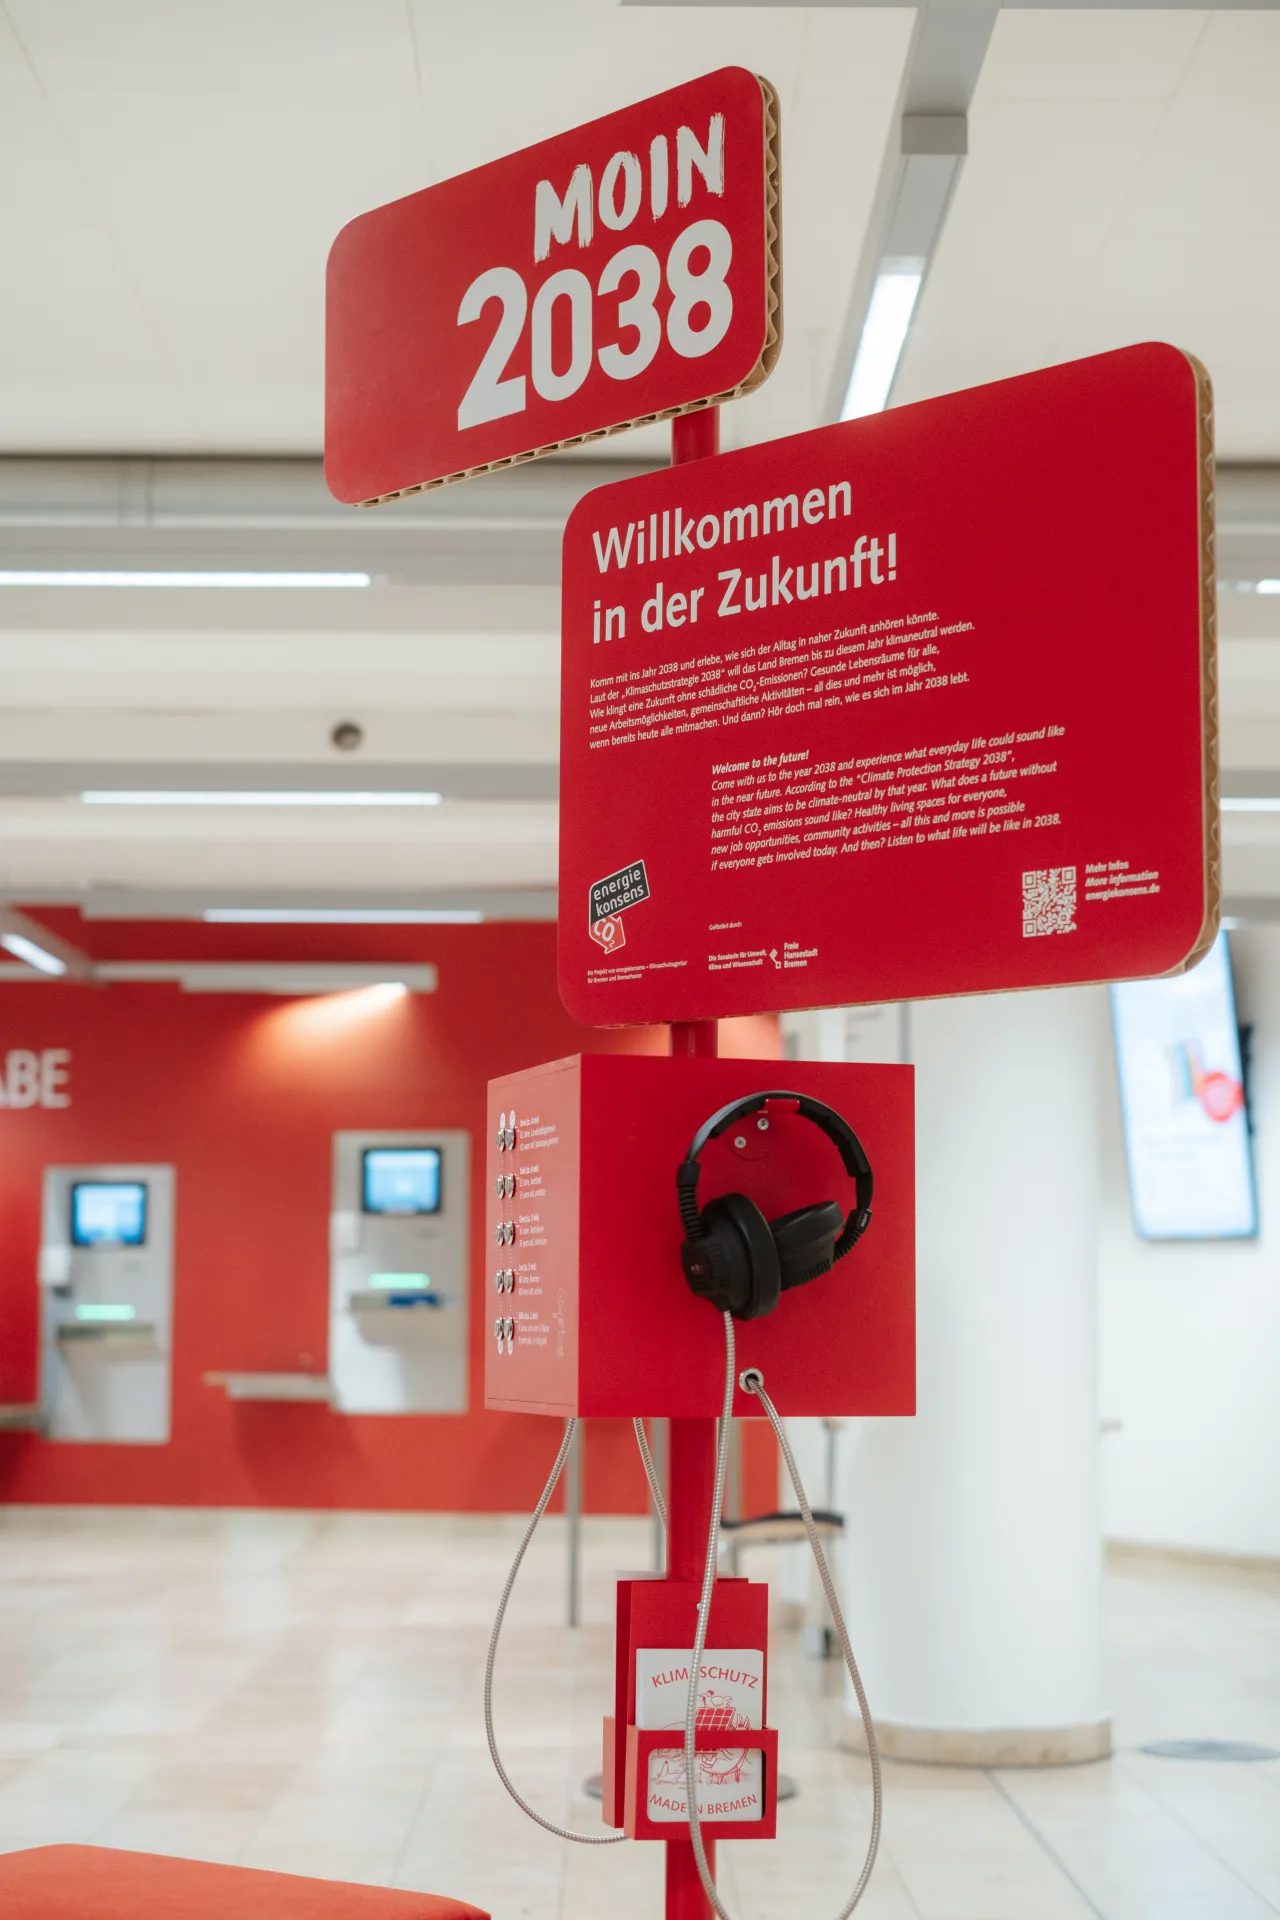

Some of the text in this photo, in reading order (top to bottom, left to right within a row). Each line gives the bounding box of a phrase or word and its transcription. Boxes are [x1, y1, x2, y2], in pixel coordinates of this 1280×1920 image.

[534, 112, 725, 264] MOIN
[457, 219, 733, 431] 2038
[592, 480, 851, 573] Willkommen
[593, 532, 897, 643] in der Zukunft!
[590, 611, 939, 689] Komm mit ins Jahr 2038 und erlebe, wie sich der Alltag in naher Zukunft anhören könnte.
[590, 692, 606, 704] Laut
[606, 689, 620, 700] der
[727, 664, 740, 677] will
[742, 662, 756, 674] das
[757, 657, 777, 671] Land
[778, 653, 809, 667] Bremen
[811, 649, 823, 661] bis
[824, 649, 834, 658] zu
[835, 642, 865, 656] diesem
[866, 637, 884, 650] Jahr
[885, 625, 938, 646] klimaneutral
[939, 621, 975, 635] werden.
[589, 661, 936, 734] neue Arbeitsmöglichkeiten, gemeinschaftliche Aktivitäten all dies und mehr ist möglich,
[589, 671, 970, 749] wenn bereits heute alle mitmachen. Und dann? Hör doch mal rein, wie es sich im Jahr 2038 lebt.
[711, 725, 1065, 791] Come with us to the year 2038 and experience what everyday life could sound like
[711, 749, 809, 775] Welcome to the future!
[711, 760, 1057, 823] the city state aims to be climate-neutral by that year. What does a future without
[710, 800, 1025, 855] new job opportunities, community activities all this and more is possible
[711, 813, 1061, 871] if everyone gets involved today. And then? Listen to what life will be like in 2038.
[593, 869, 641, 901] energie
[596, 885, 644, 917] konsens
[1109, 870, 1159, 886] information
[784, 942, 799, 950] Freie
[784, 959, 807, 968] Bremen
[0, 1048, 71, 1109] BE
[651, 1666, 759, 1689] KLIMSCHUTZ
[650, 1793, 687, 1813] MADE
[708, 1794, 757, 1814] BREMEN
